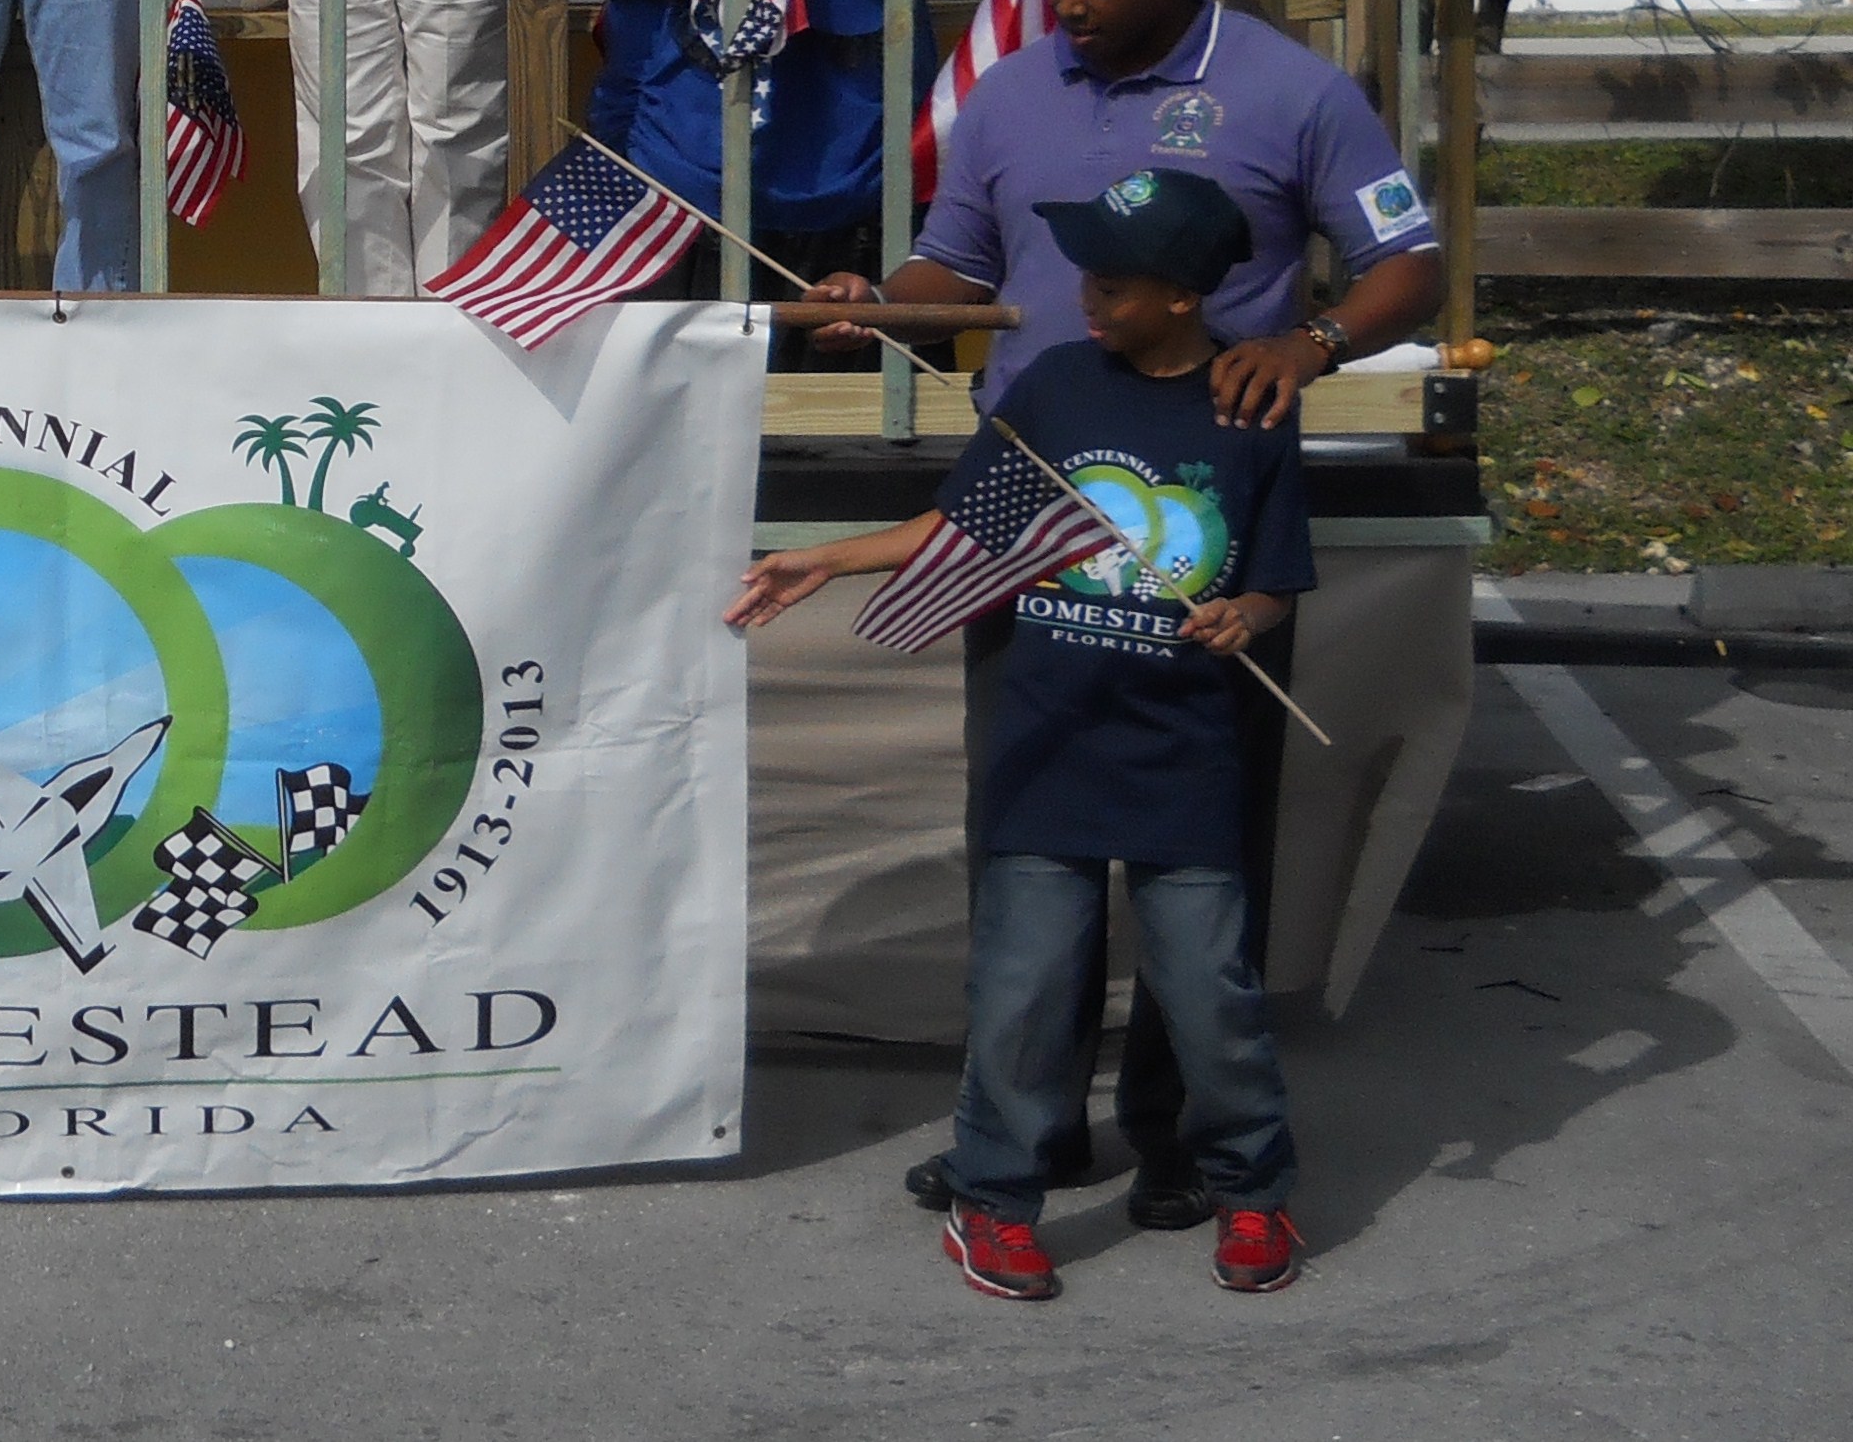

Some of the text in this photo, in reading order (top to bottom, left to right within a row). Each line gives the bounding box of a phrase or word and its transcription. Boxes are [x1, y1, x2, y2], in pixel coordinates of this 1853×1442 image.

[1062, 449, 1163, 487] CENTENNIAL
[1015, 593, 1176, 638] OMESTE
[1051, 629, 1175, 658] FLORIDA
[408, 660, 545, 929] 1913-2013
